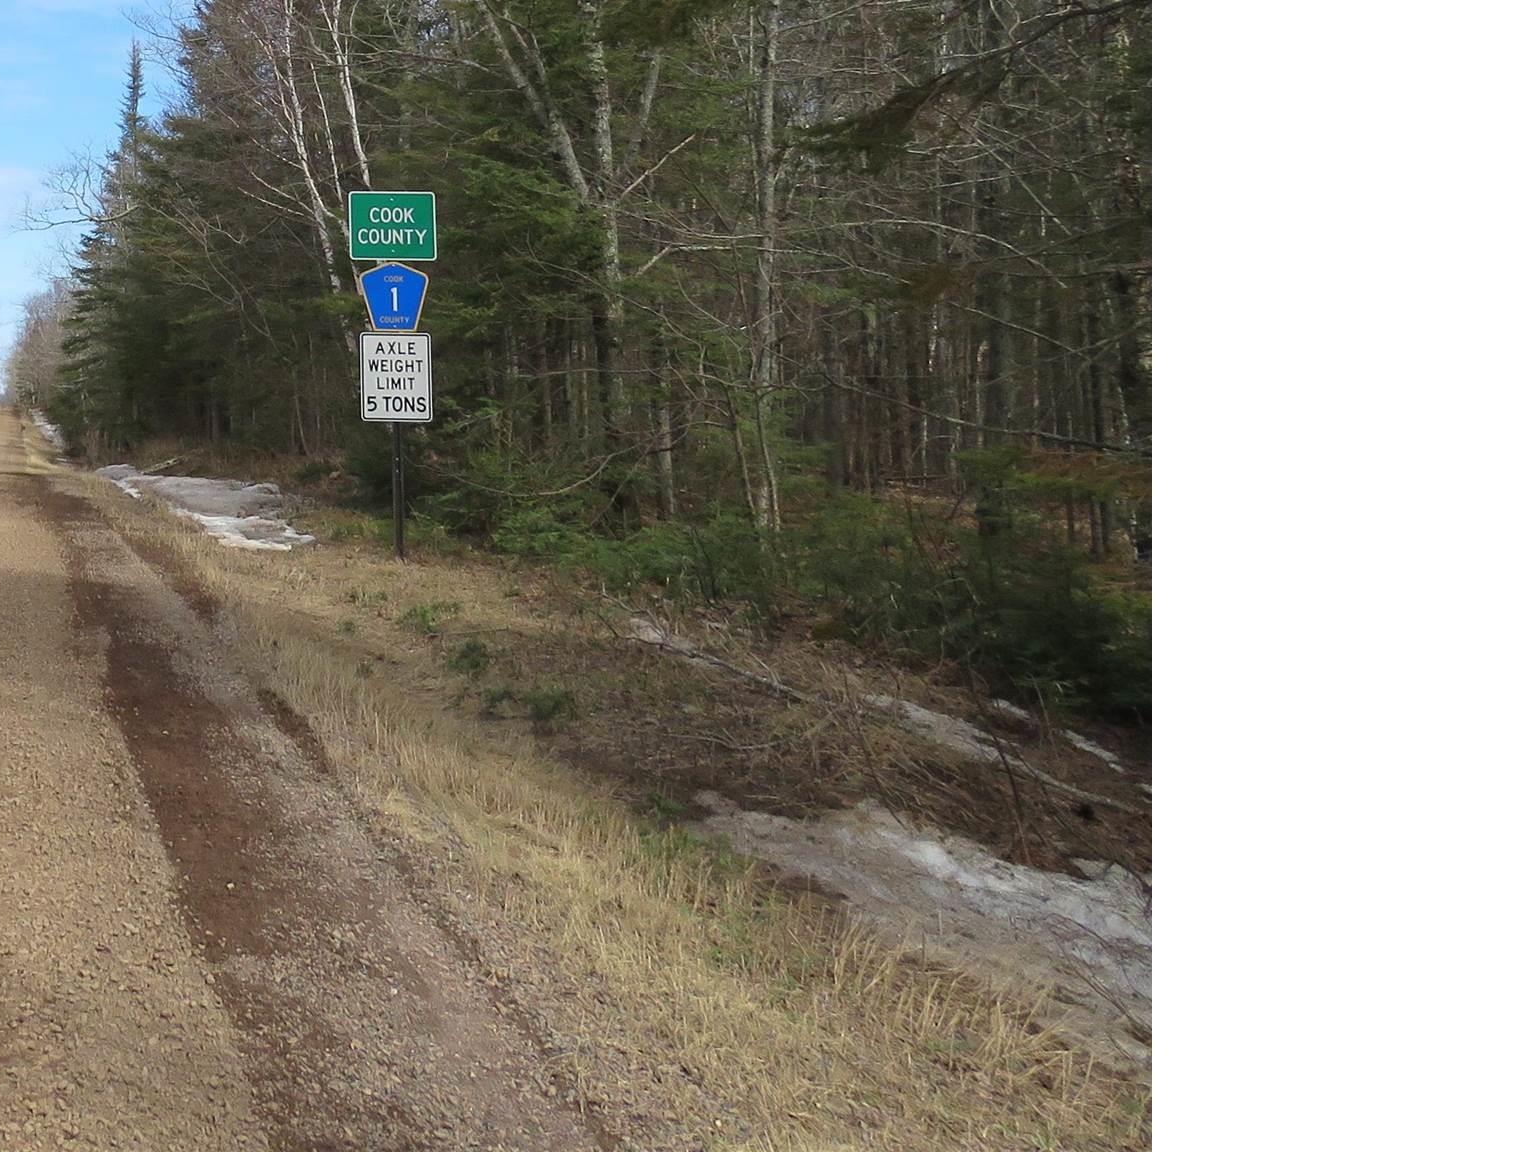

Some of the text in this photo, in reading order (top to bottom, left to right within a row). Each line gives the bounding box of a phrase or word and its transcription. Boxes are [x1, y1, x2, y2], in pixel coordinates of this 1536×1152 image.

[369, 207, 415, 223] COOK
[358, 228, 427, 245] COUNTY
[390, 287, 398, 312] 1
[379, 315, 409, 324] COUNTY
[375, 342, 416, 355] AXLE
[368, 359, 423, 373] WEIGHT
[376, 377, 415, 390] LIMIT
[367, 396, 427, 413] 5 TONS
